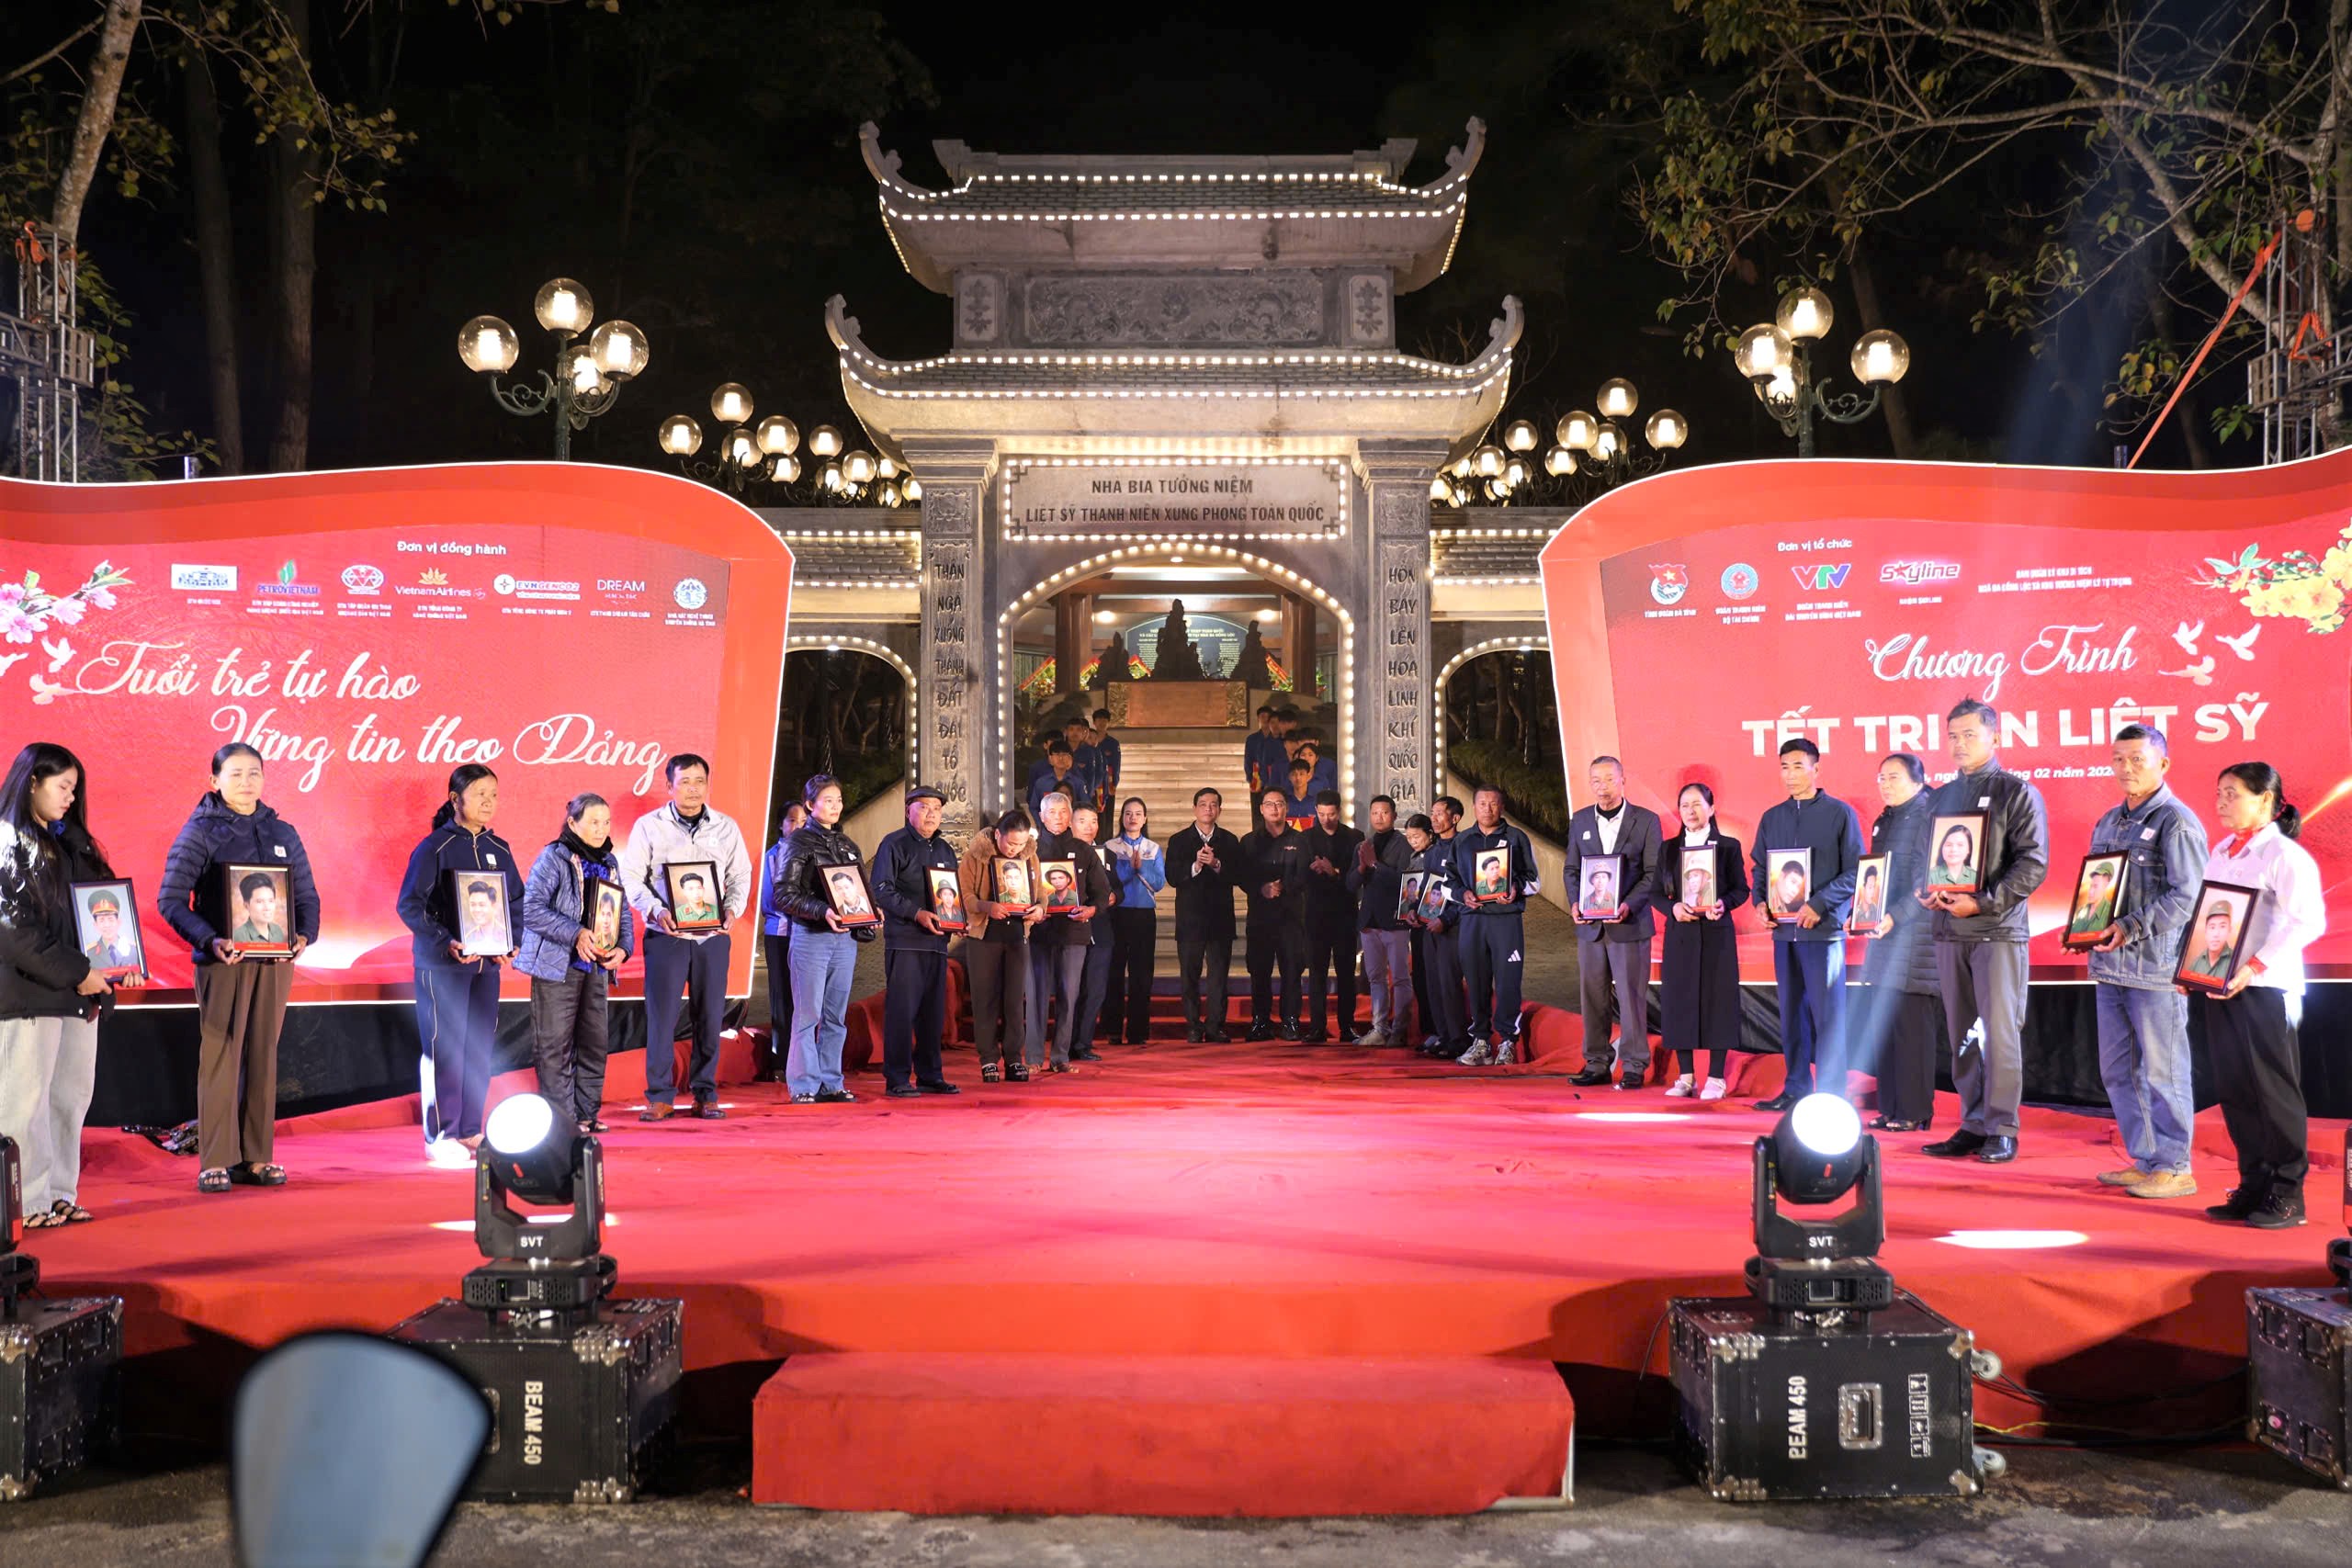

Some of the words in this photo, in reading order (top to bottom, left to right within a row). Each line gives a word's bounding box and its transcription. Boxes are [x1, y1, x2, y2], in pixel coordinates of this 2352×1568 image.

[1091, 478, 1122, 493] NHÀ
[1128, 479, 1153, 493] BIA
[1159, 473, 1209, 493] TƯỞNG
[1214, 474, 1253, 498] NIỆM
[1025, 504, 1056, 526] LIỆT
[1081, 508, 1125, 522] THANH
[1129, 502, 1159, 522] NIÊN
[1164, 507, 1198, 521] XUNG
[1203, 507, 1247, 521] PHONG
[1250, 502, 1284, 521] TOÀN
[1288, 500, 1324, 523] QUỐC
[397, 540, 423, 552] Đơn
[426, 542, 438, 554] vị
[475, 544, 506, 555] hành
[1778, 541, 1798, 551] Đơn
[1802, 541, 1812, 552] vị
[934, 558, 965, 580] THÂN
[1388, 560, 1416, 583] HỒN
[1792, 563, 1852, 590] VTV
[597, 580, 645, 592] DREAM
[1389, 599, 1417, 615] BAY
[1390, 626, 1416, 646] LÊN
[76, 640, 199, 695] Tuổi
[211, 648, 271, 697] trẻ
[282, 649, 331, 705] tự
[336, 651, 421, 700] hào
[1388, 655, 1419, 677] HÓA
[1865, 634, 2011, 703] Chương
[2021, 623, 2138, 676] Trình
[1388, 689, 1418, 707] LINH
[1388, 716, 1417, 738] KHÍ
[1742, 705, 1840, 757] TẾT
[1853, 714, 1940, 752] TRI
[2194, 692, 2269, 743] SỸ
[346, 712, 405, 763] tin
[417, 715, 504, 764] theo
[1387, 743, 1419, 769] QUỐC
[2033, 769, 2051, 778] 02
[2052, 767, 2085, 778] năm
[1389, 785, 1417, 801] GIA
[521, 1236, 543, 1247] SVT
[1809, 1236, 1833, 1247] SVT
[1788, 1376, 1806, 1407] 450
[525, 1381, 543, 1431] BEAM
[1788, 1409, 1807, 1459] BEAM
[524, 1434, 542, 1465] 450
